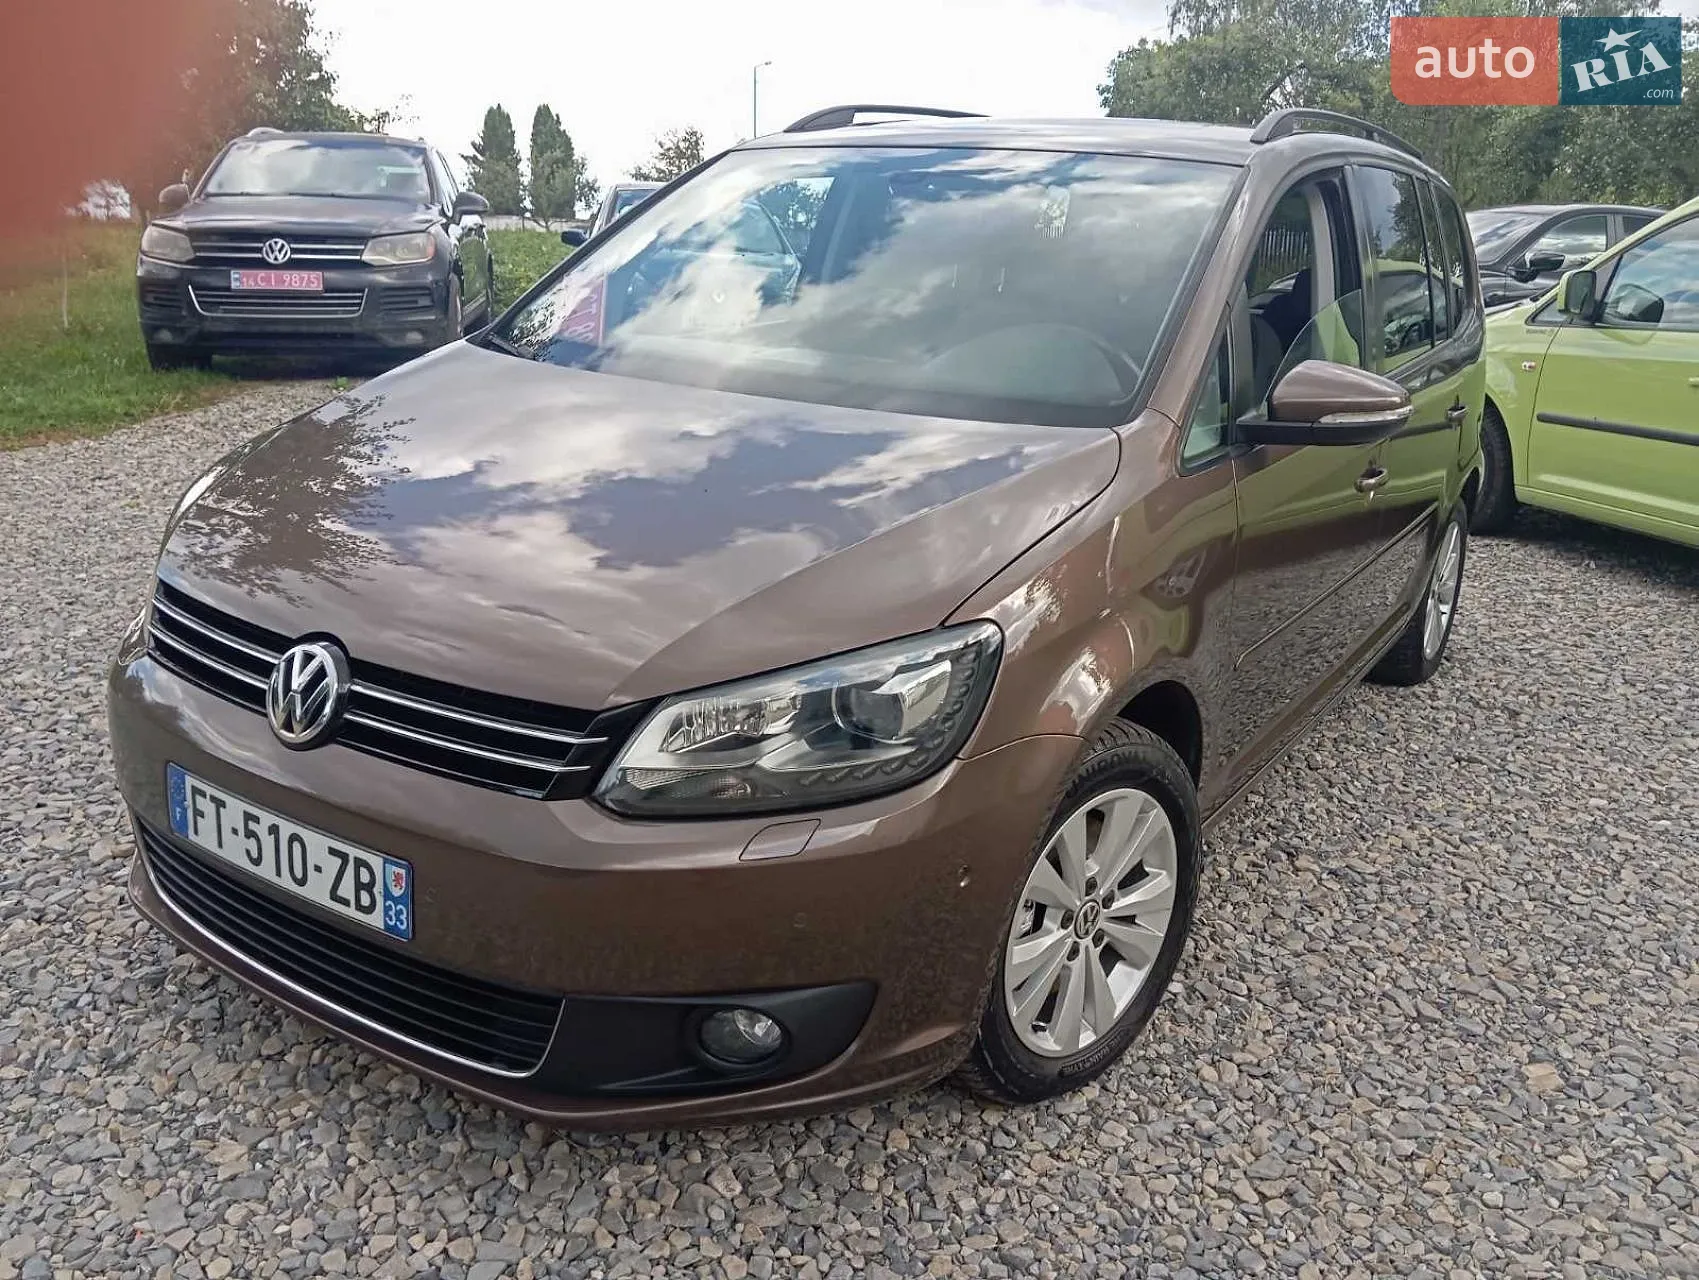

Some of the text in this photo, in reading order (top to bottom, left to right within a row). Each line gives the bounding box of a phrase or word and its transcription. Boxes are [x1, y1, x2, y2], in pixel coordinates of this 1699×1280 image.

[283, 273, 318, 287] 9875
[190, 784, 377, 916] FT-510-ZB
[385, 900, 408, 930] 33
